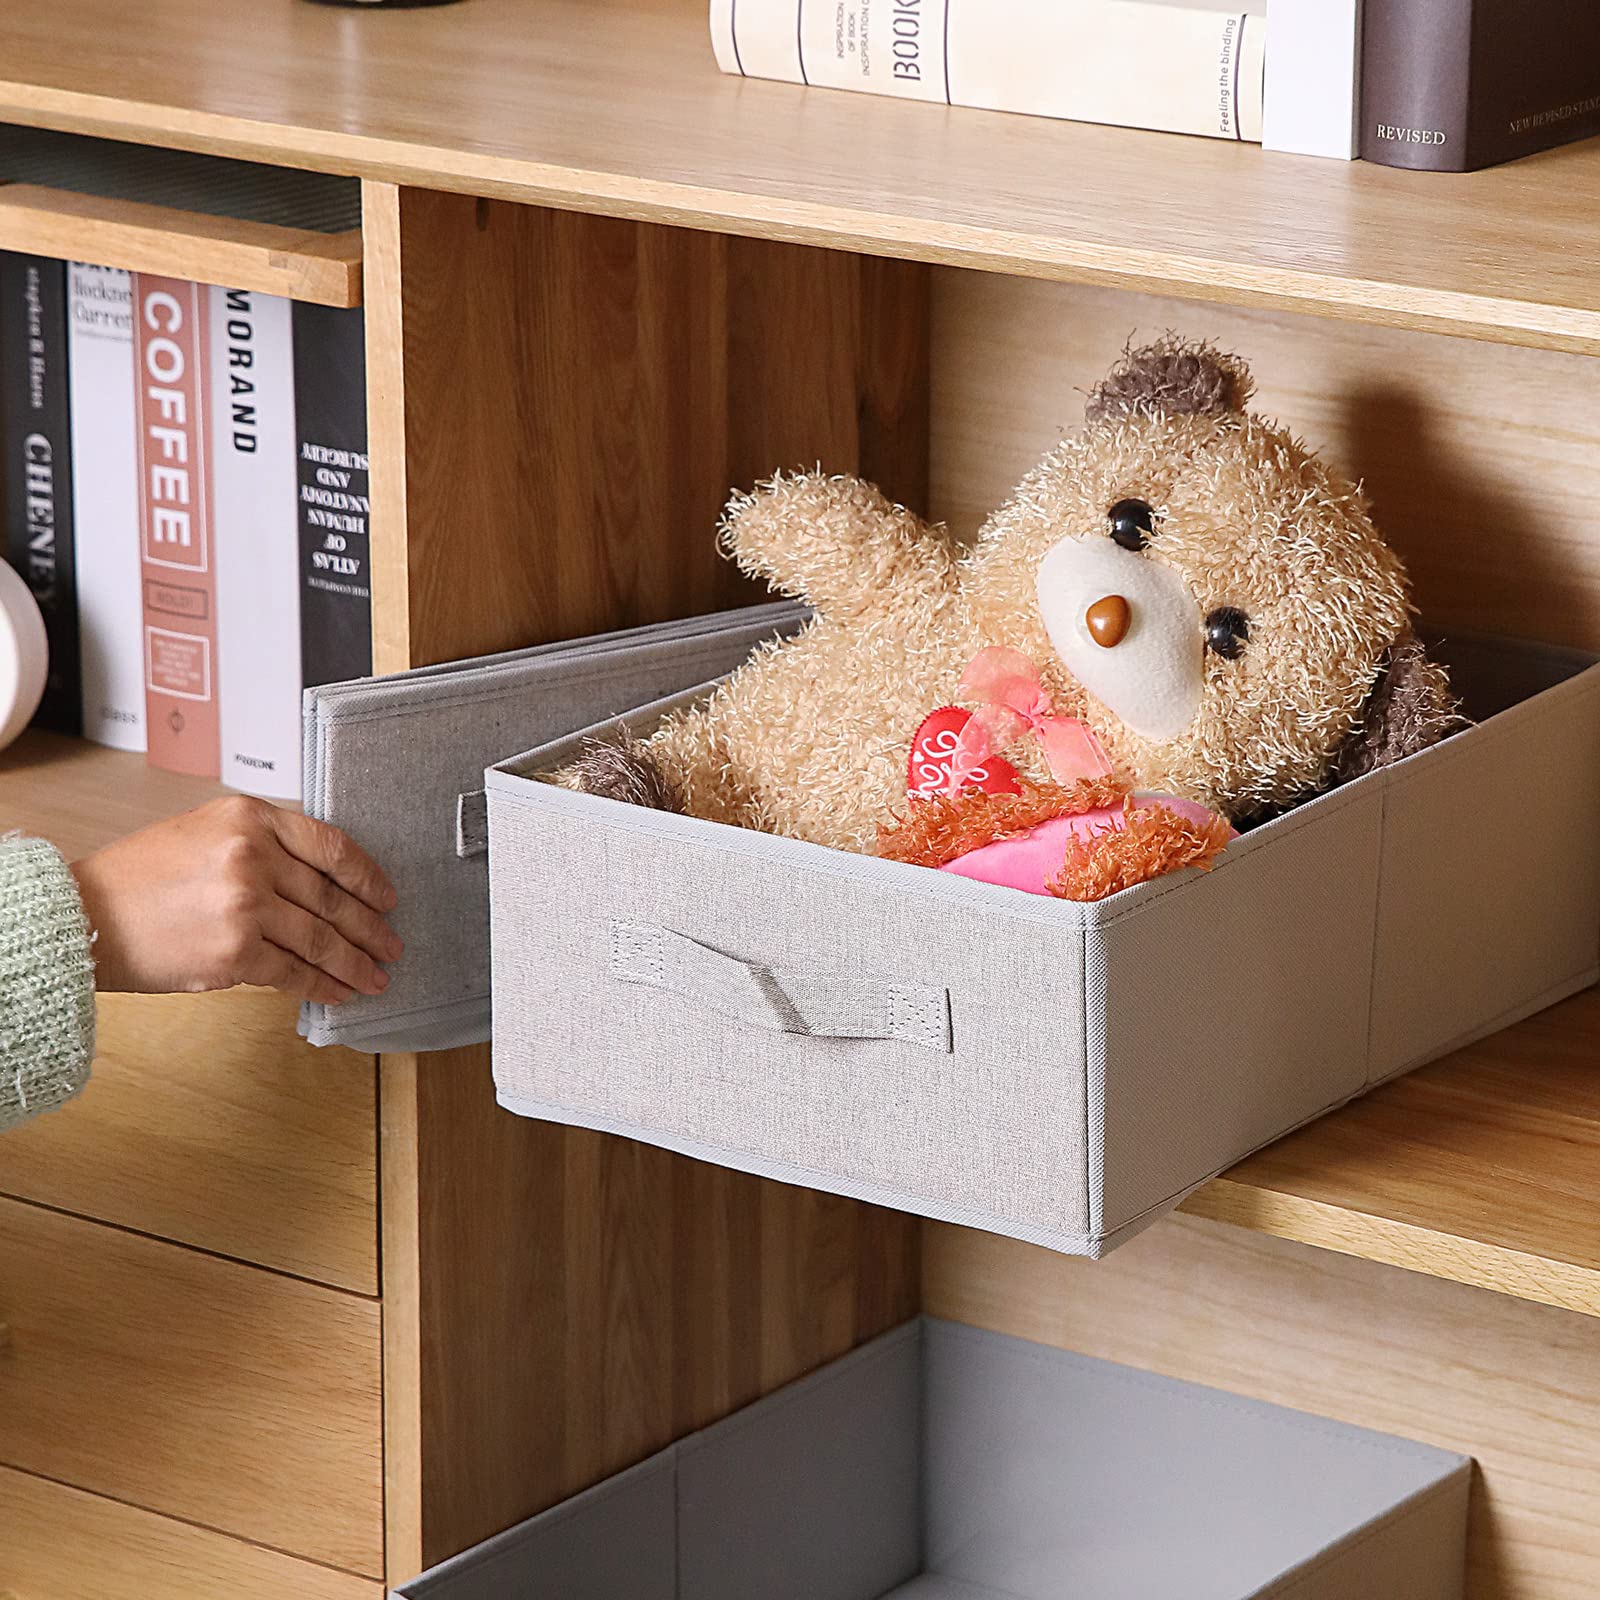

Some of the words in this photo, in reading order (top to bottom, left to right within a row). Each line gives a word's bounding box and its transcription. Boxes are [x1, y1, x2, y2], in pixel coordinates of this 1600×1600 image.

[861, 7, 870, 76] INSPIRATION
[893, 0, 921, 81] BOOK
[1220, 18, 1236, 65] binding
[1219, 66, 1229, 86] the
[1219, 89, 1230, 133] Feeling
[1376, 124, 1447, 146] REVISED
[226, 289, 258, 454] MORAND
[144, 290, 192, 548] COFFEE
[301, 442, 369, 471] SURGERY
[315, 467, 351, 489] AND
[301, 484, 371, 513] ANATOMY
[307, 507, 365, 534] HUMAN
[323, 533, 347, 552] OF
[312, 551, 360, 575] ATLAS
